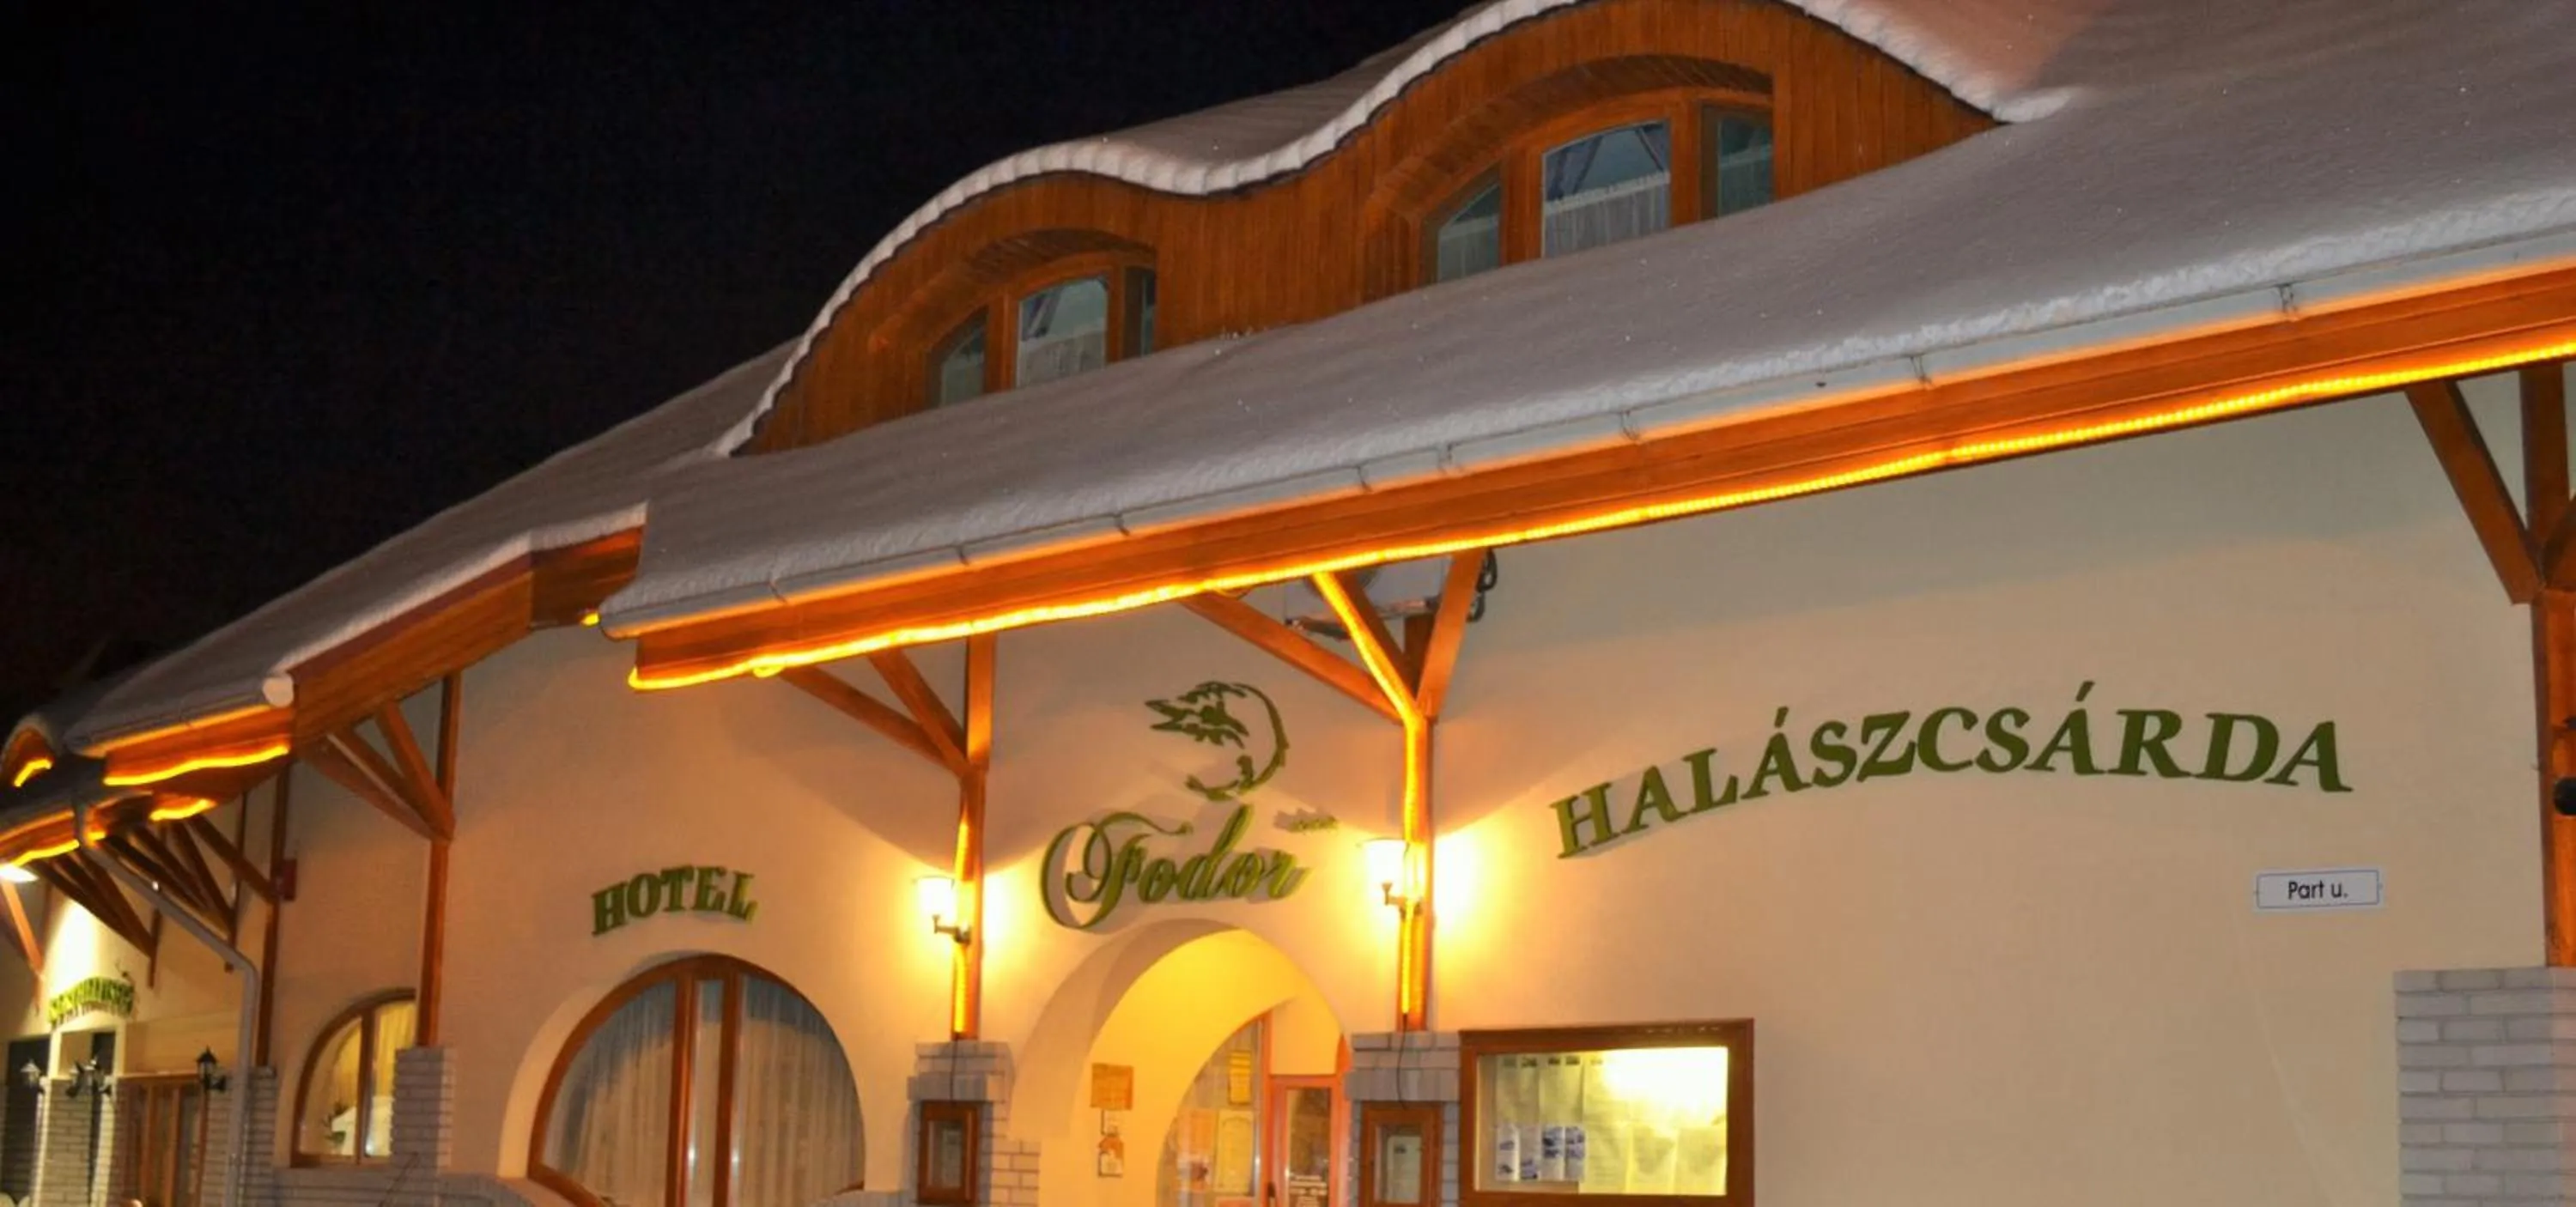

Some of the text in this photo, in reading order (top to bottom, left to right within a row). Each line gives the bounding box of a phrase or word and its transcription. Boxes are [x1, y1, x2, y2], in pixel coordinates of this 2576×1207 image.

[1550, 681, 2354, 858] HALÁSZCSÁRDA
[591, 864, 759, 937] HOTEL
[1040, 804, 1311, 930] Fodor
[2287, 879, 2349, 900] Part u.
